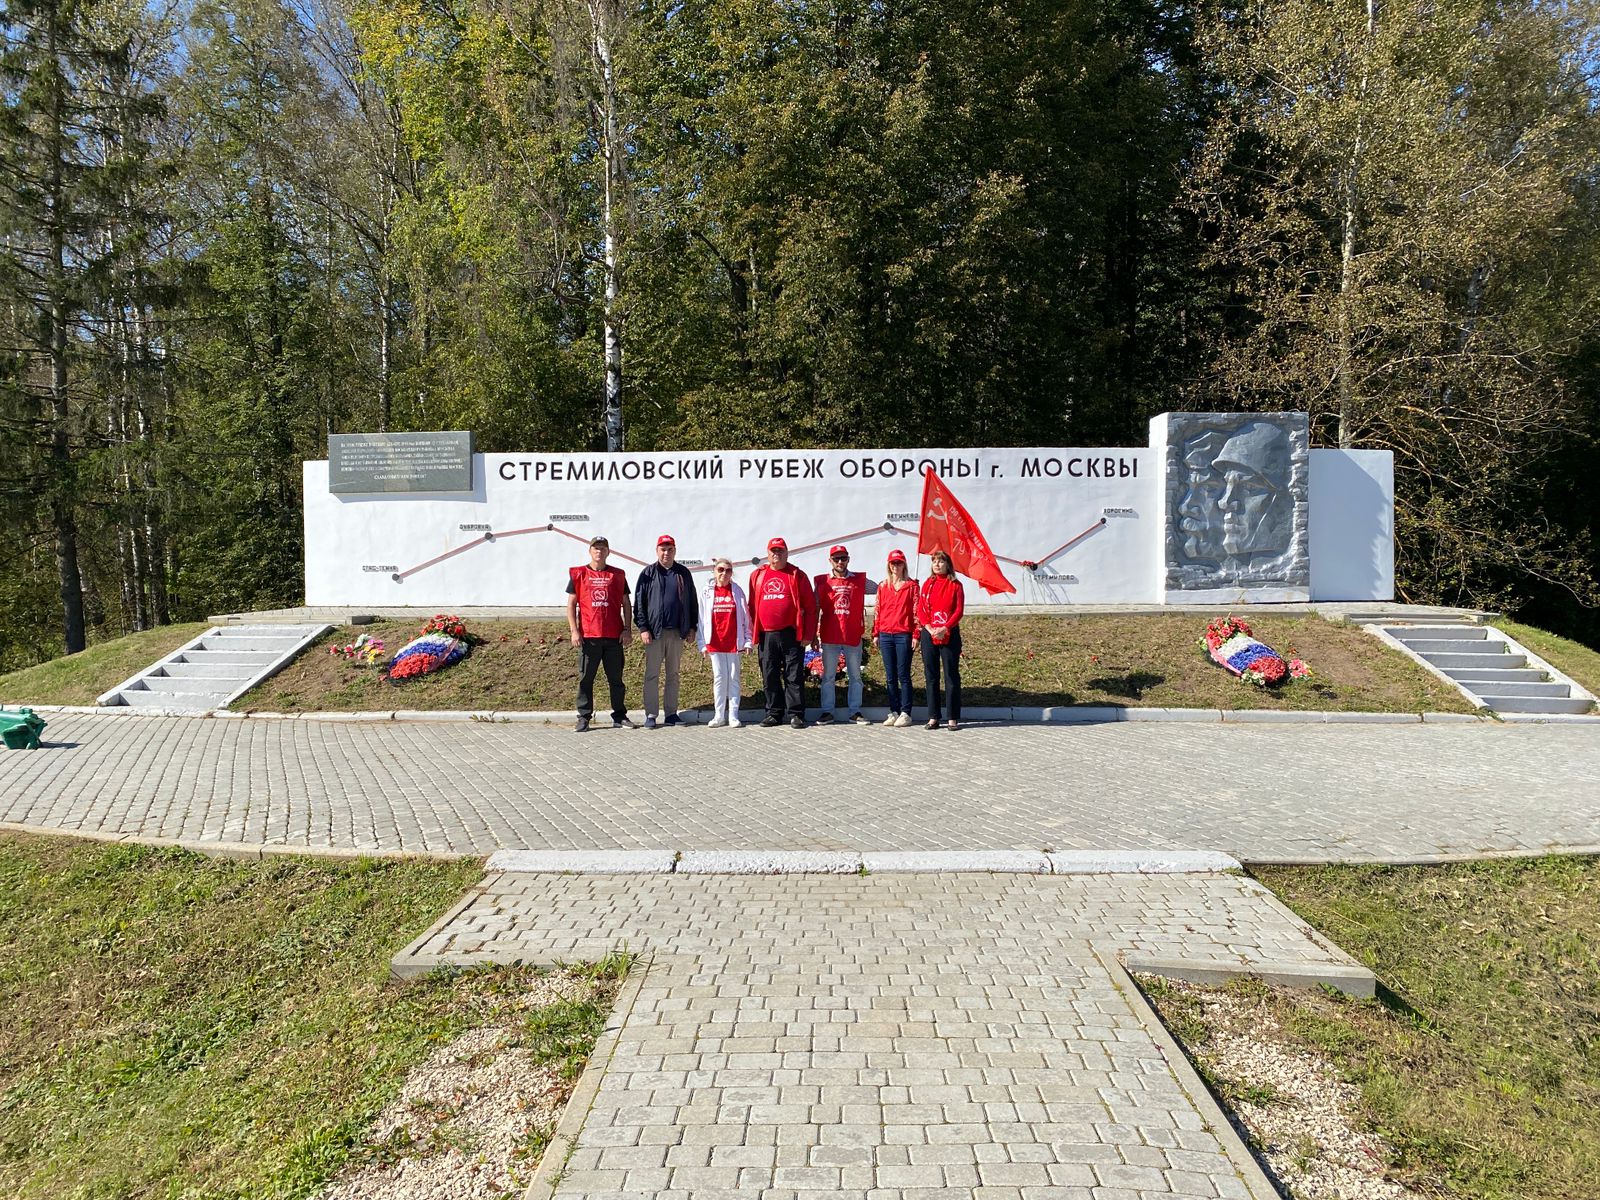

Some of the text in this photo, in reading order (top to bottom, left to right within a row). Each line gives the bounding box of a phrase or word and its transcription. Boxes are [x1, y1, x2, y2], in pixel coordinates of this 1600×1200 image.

[499, 454, 1138, 481] СТРЕМИЛОВСКИЙ РУБЕЖ ОБОРОНЫ г. МОСКВЫ
